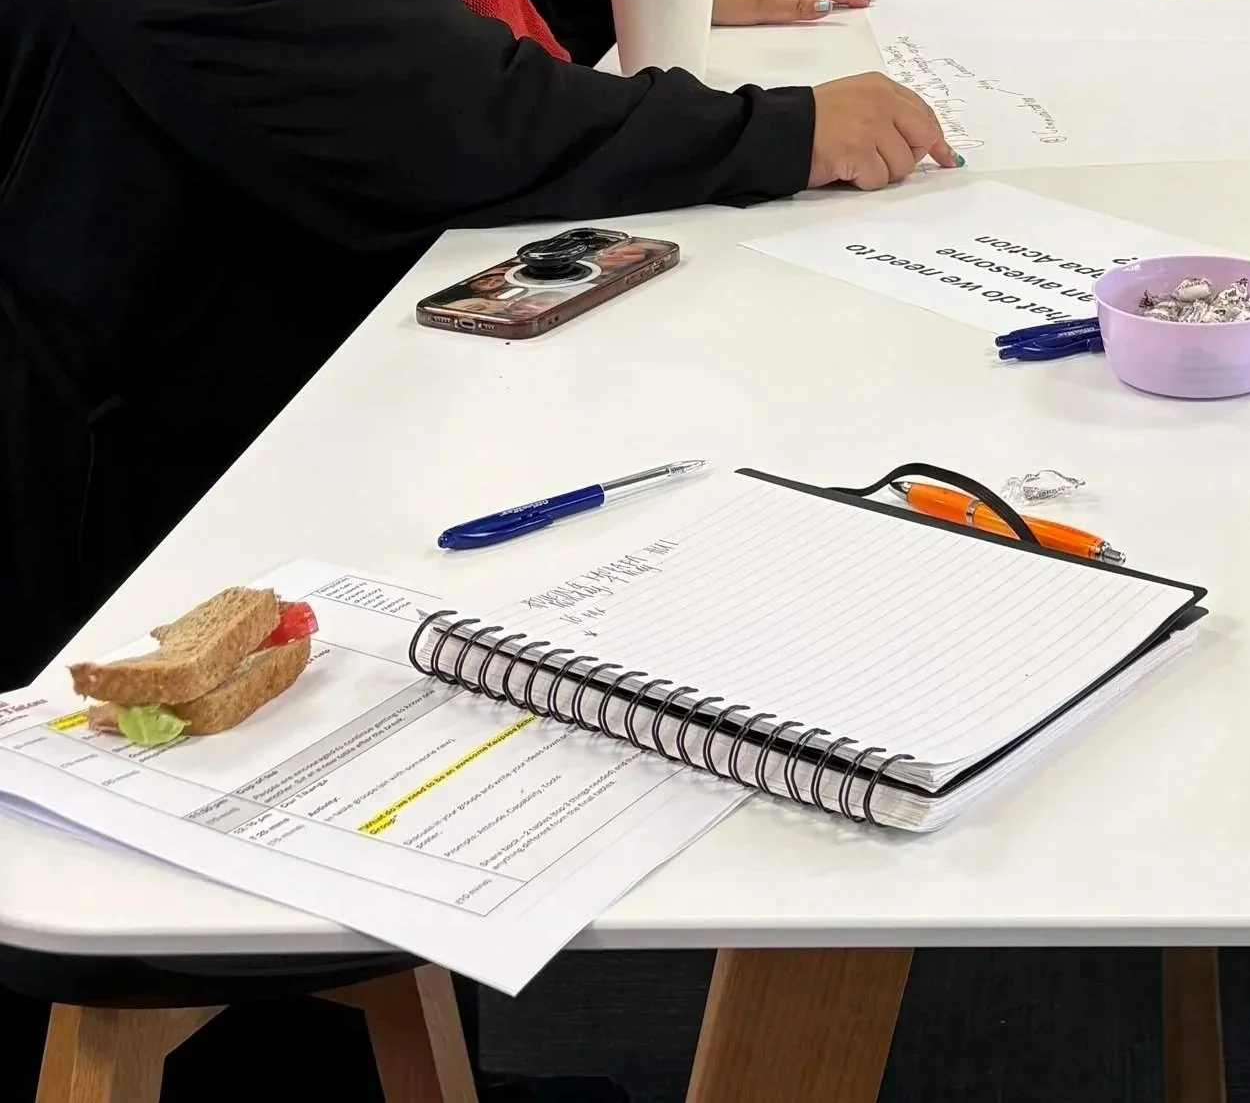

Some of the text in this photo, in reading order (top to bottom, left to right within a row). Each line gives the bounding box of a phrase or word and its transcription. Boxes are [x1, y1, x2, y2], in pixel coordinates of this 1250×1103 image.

[935, 247, 1094, 303] an awesome
[974, 234, 1062, 264] Action
[845, 244, 1073, 324] hat do we need to
